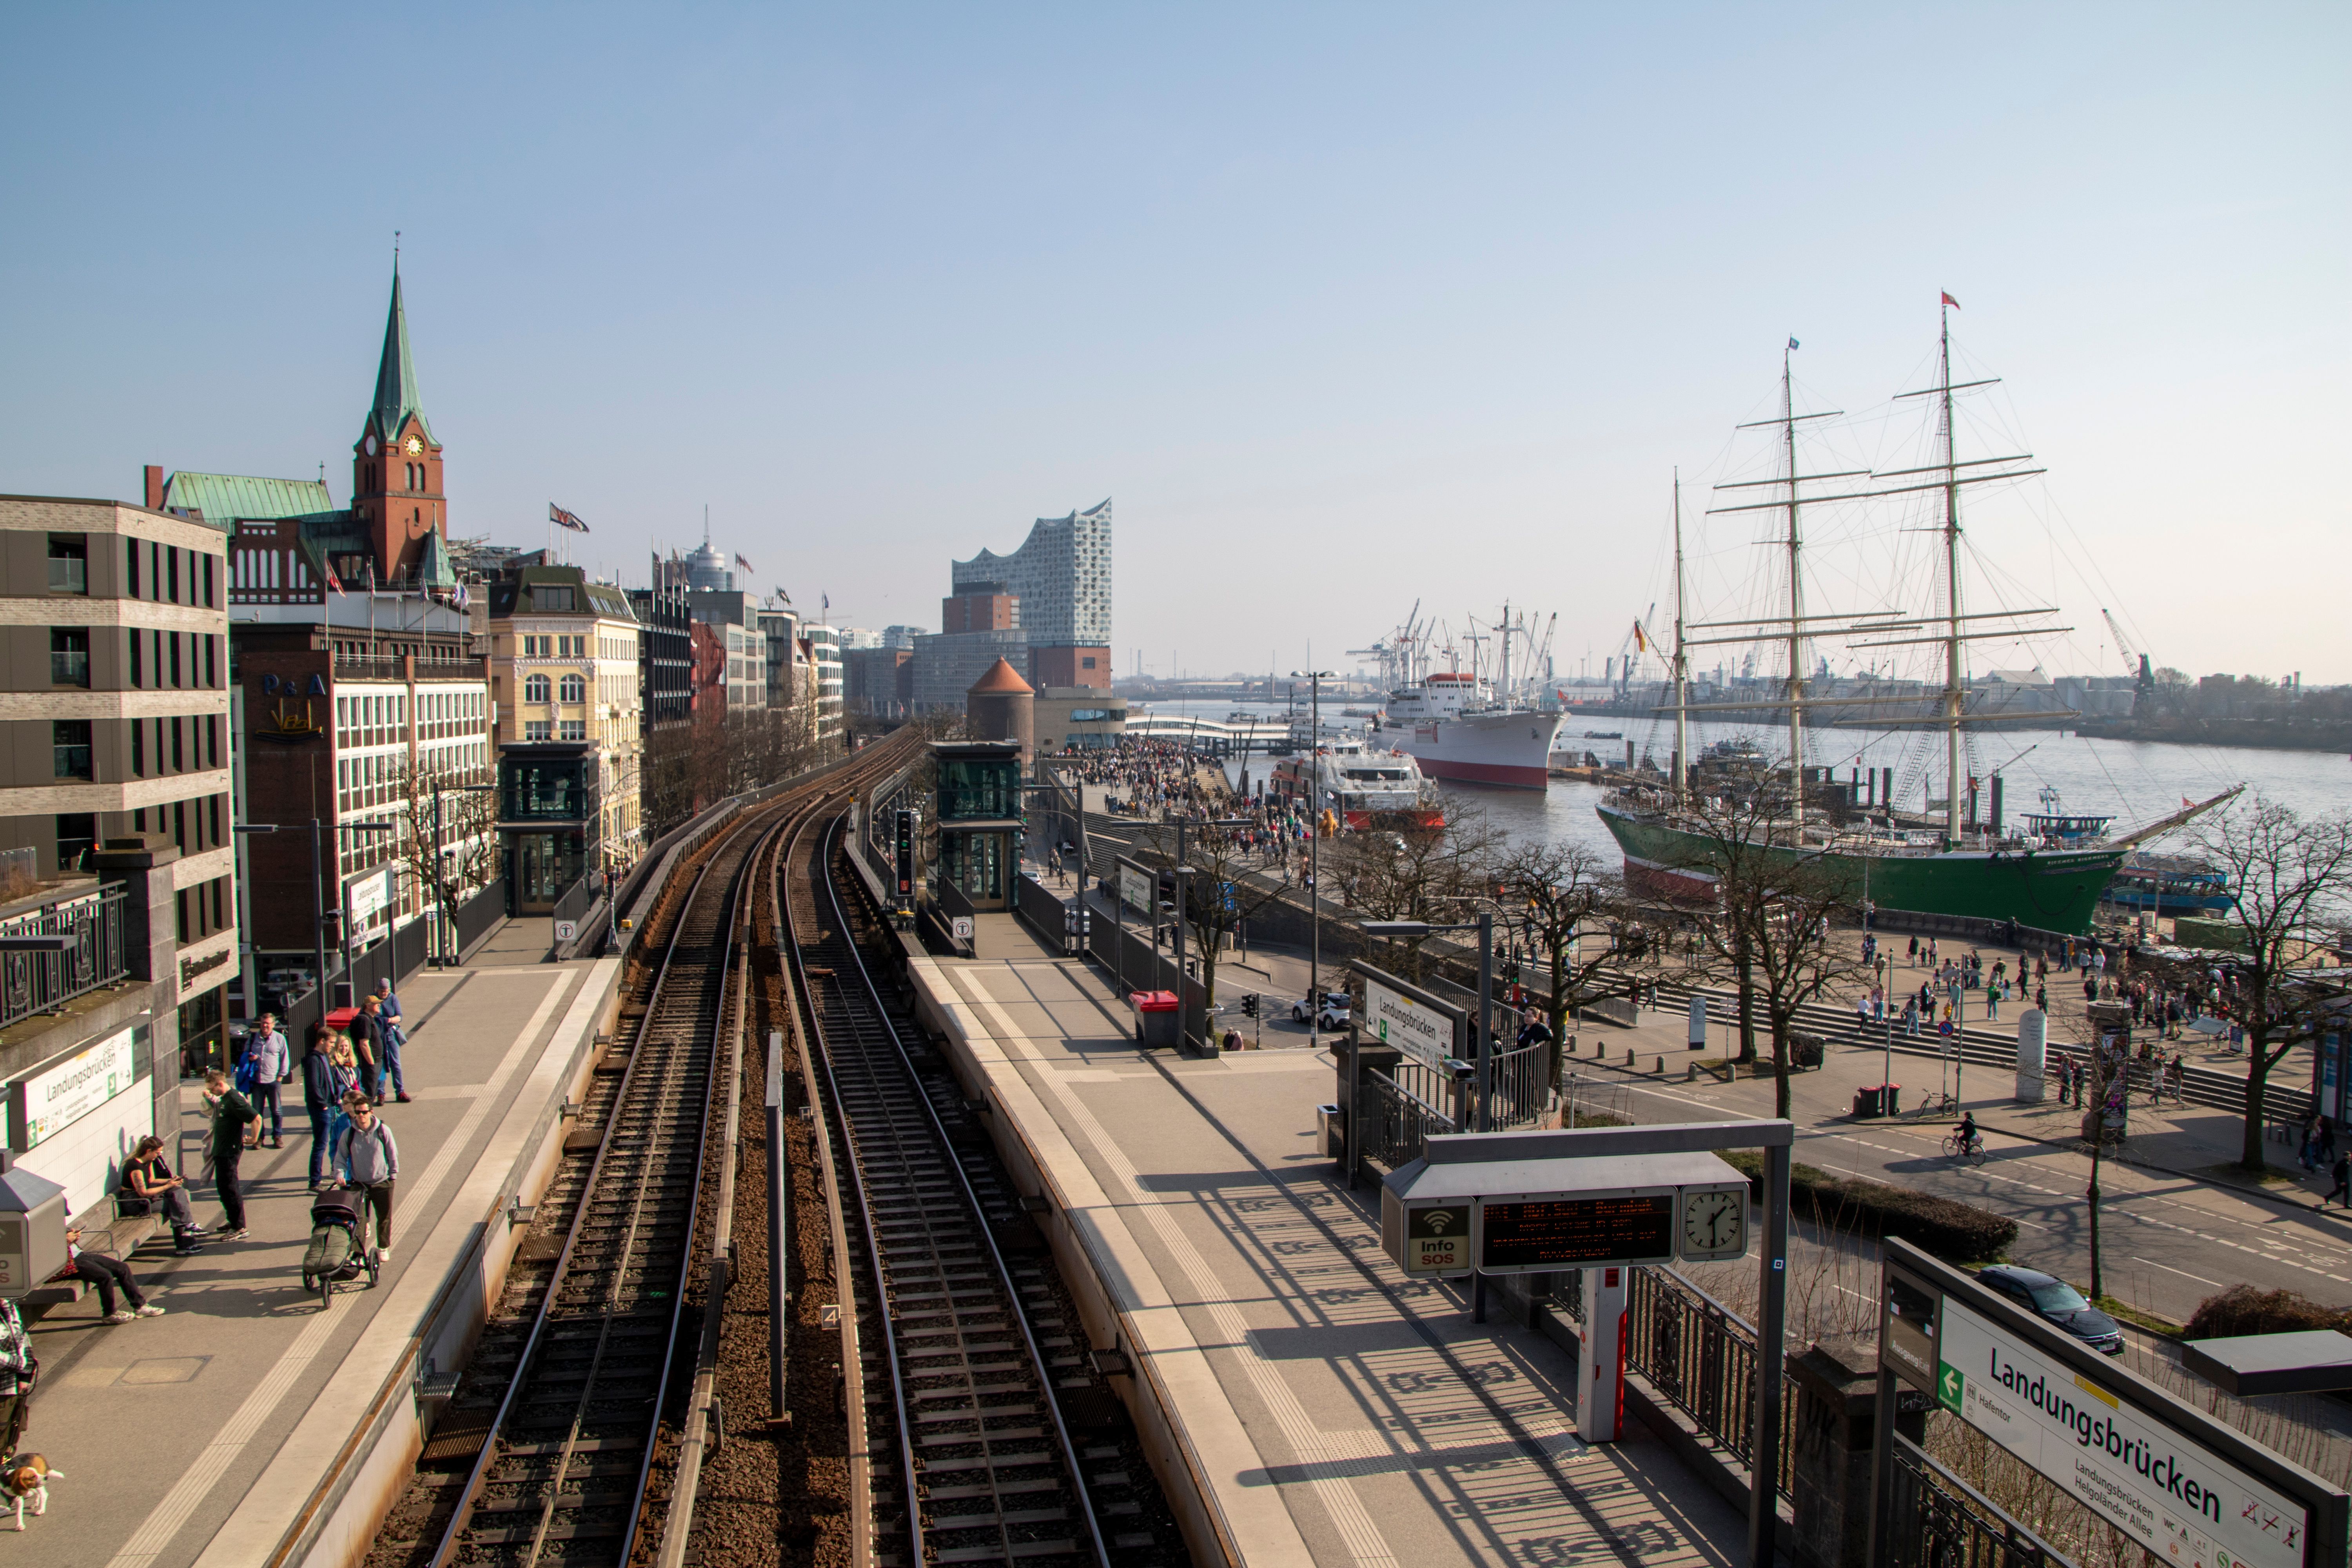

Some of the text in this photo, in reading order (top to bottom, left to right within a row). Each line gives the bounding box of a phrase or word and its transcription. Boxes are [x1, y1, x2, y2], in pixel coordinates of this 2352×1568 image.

[264, 674, 326, 696] P & A
[1379, 996, 1436, 1040] Landungsbrücken
[47, 1052, 116, 1102] Landungsbrücken
[802, 1109, 810, 1121] H
[1421, 1240, 1454, 1252] Info
[1421, 1254, 1454, 1265] SOS
[824, 1309, 838, 1325] 4
[1892, 1339, 1931, 1374] Ausgang Exit
[2077, 1377, 2085, 1388] U3
[1979, 1394, 2011, 1423] Hafentor
[1991, 1347, 2221, 1524] Landungsbrücken
[2075, 1458, 2154, 1521] Landungsbrücken
[2075, 1475, 2153, 1539] Helgoländer Allee
[2163, 1517, 2175, 1532] WC
